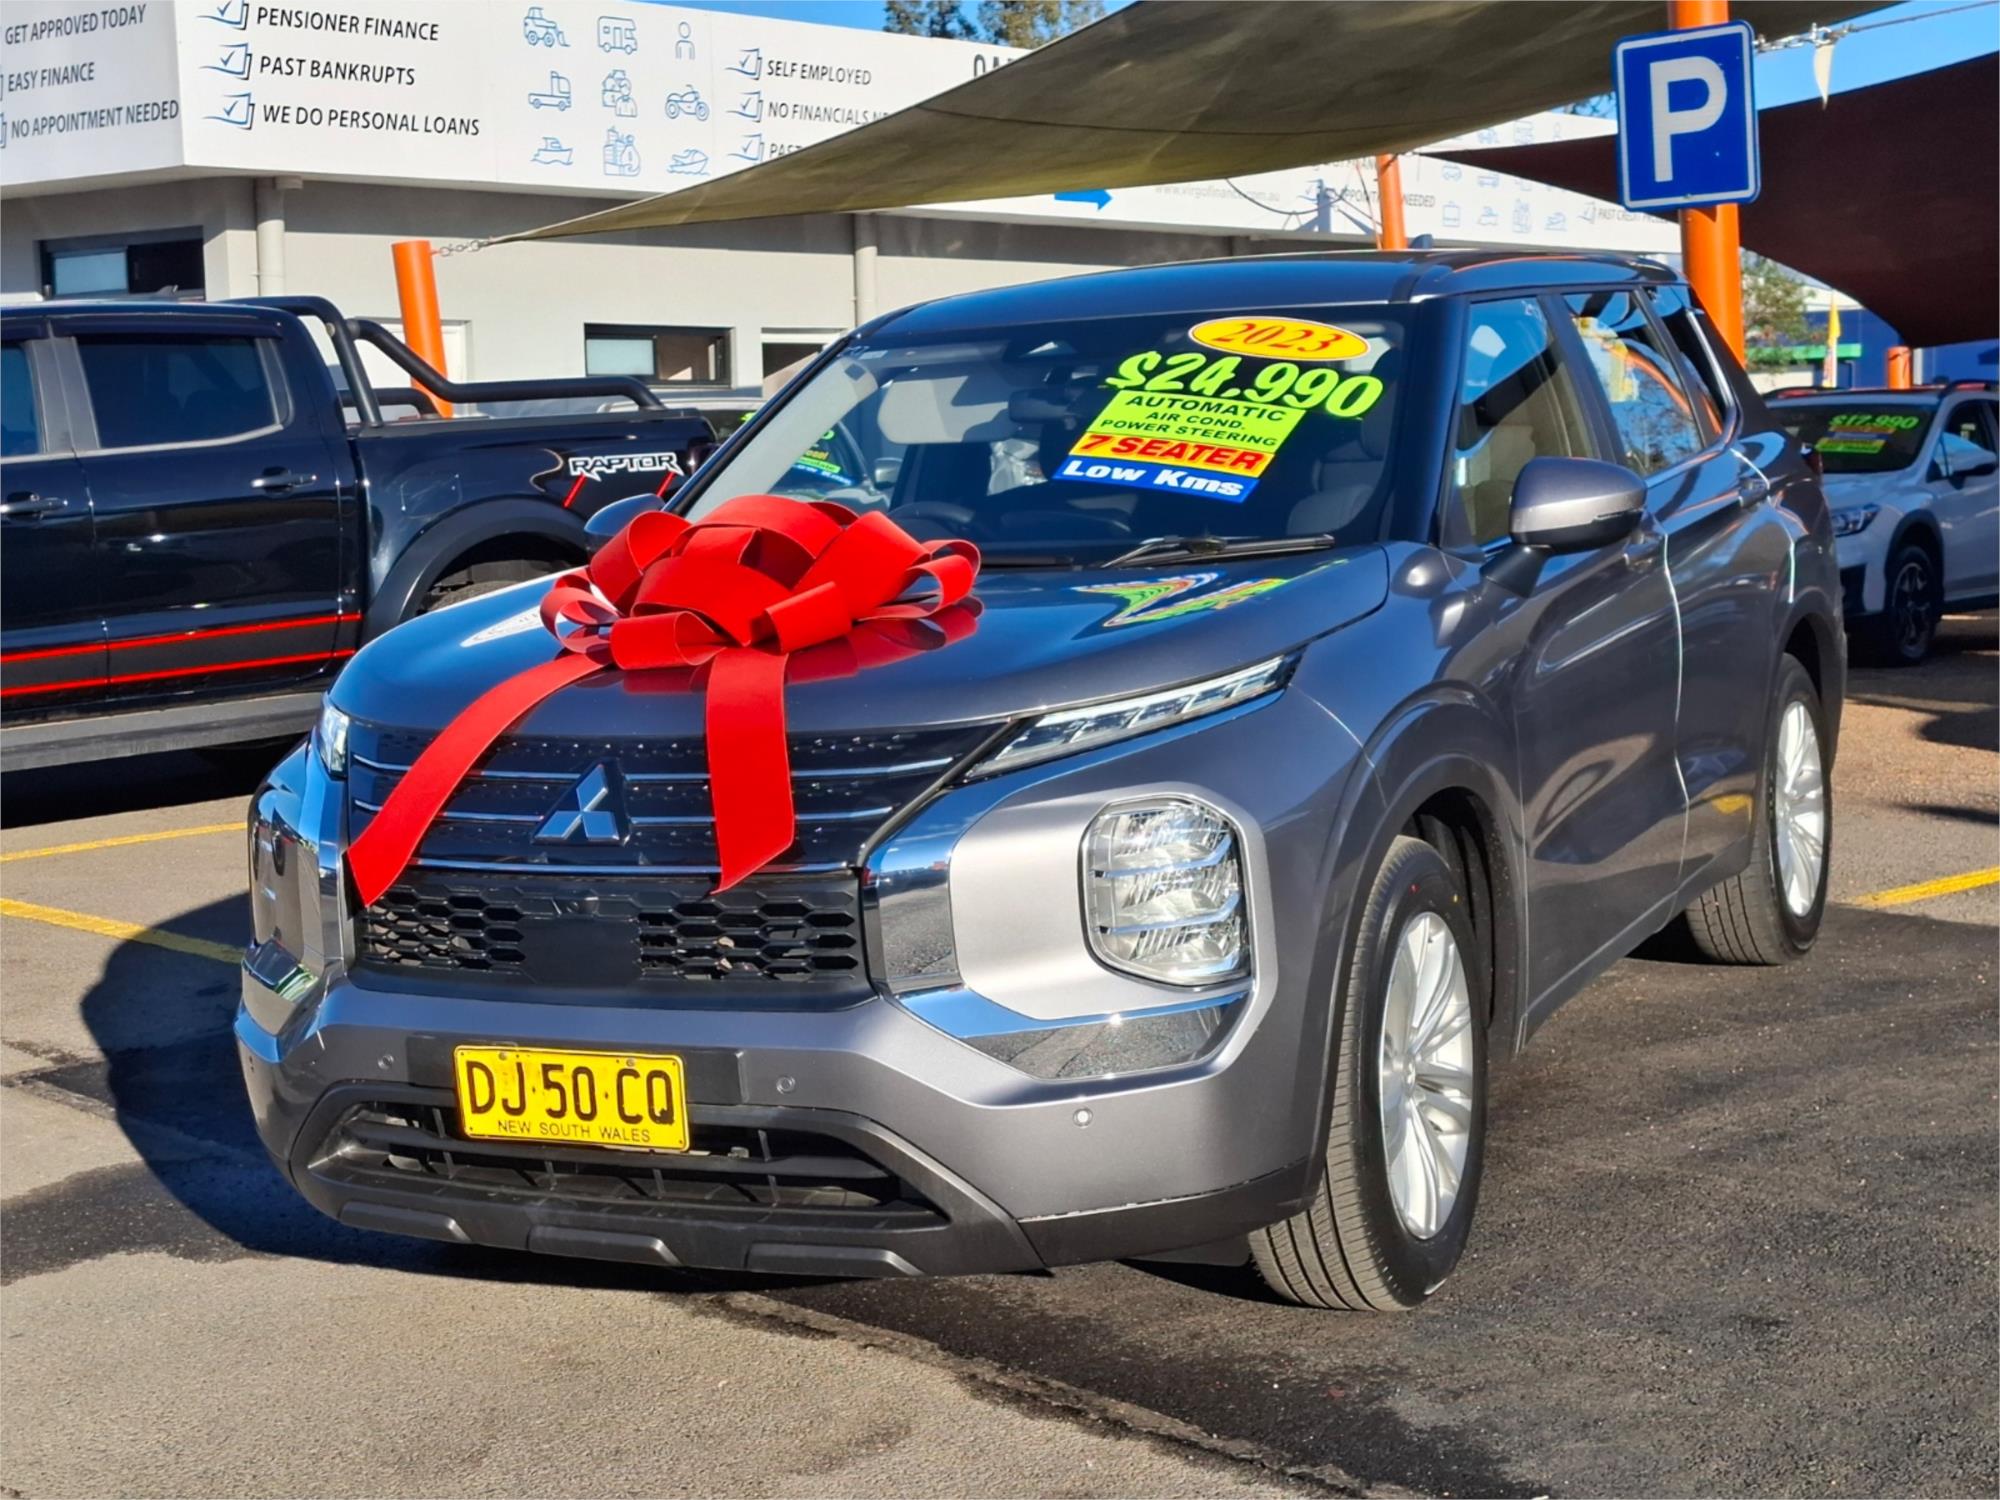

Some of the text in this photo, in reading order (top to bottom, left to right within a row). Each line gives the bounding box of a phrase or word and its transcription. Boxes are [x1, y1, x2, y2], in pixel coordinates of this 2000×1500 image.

[5, 4, 147, 45] GET APPROVED TODAY
[257, 7, 439, 41] PENSIONER FINANCE
[8, 62, 95, 92] EASY FINANCE
[260, 56, 415, 85] PAST BANKRUPTS
[767, 60, 872, 86] SELF EMPLOYED
[11, 100, 179, 139] NO APPOINTMENT NEEDED
[263, 104, 480, 136] WE DO PERSONAL LOANS
[768, 102, 789, 118] NO
[792, 104, 869, 126] FINANCIALS
[1649, 56, 1728, 183] P
[1215, 323, 1343, 352] 2023
[1105, 350, 1384, 418] $24,990
[1126, 395, 1288, 422] AUTOMATIC
[1145, 411, 1246, 430] AIR COND.
[1100, 419, 1277, 447] POWER STEERING
[568, 452, 685, 482] RAPTOR
[1080, 435, 1265, 470] 7 SEATER
[1063, 459, 1244, 496] Low Kms
[498, 1119, 650, 1143] NEW SOUTH WALES
